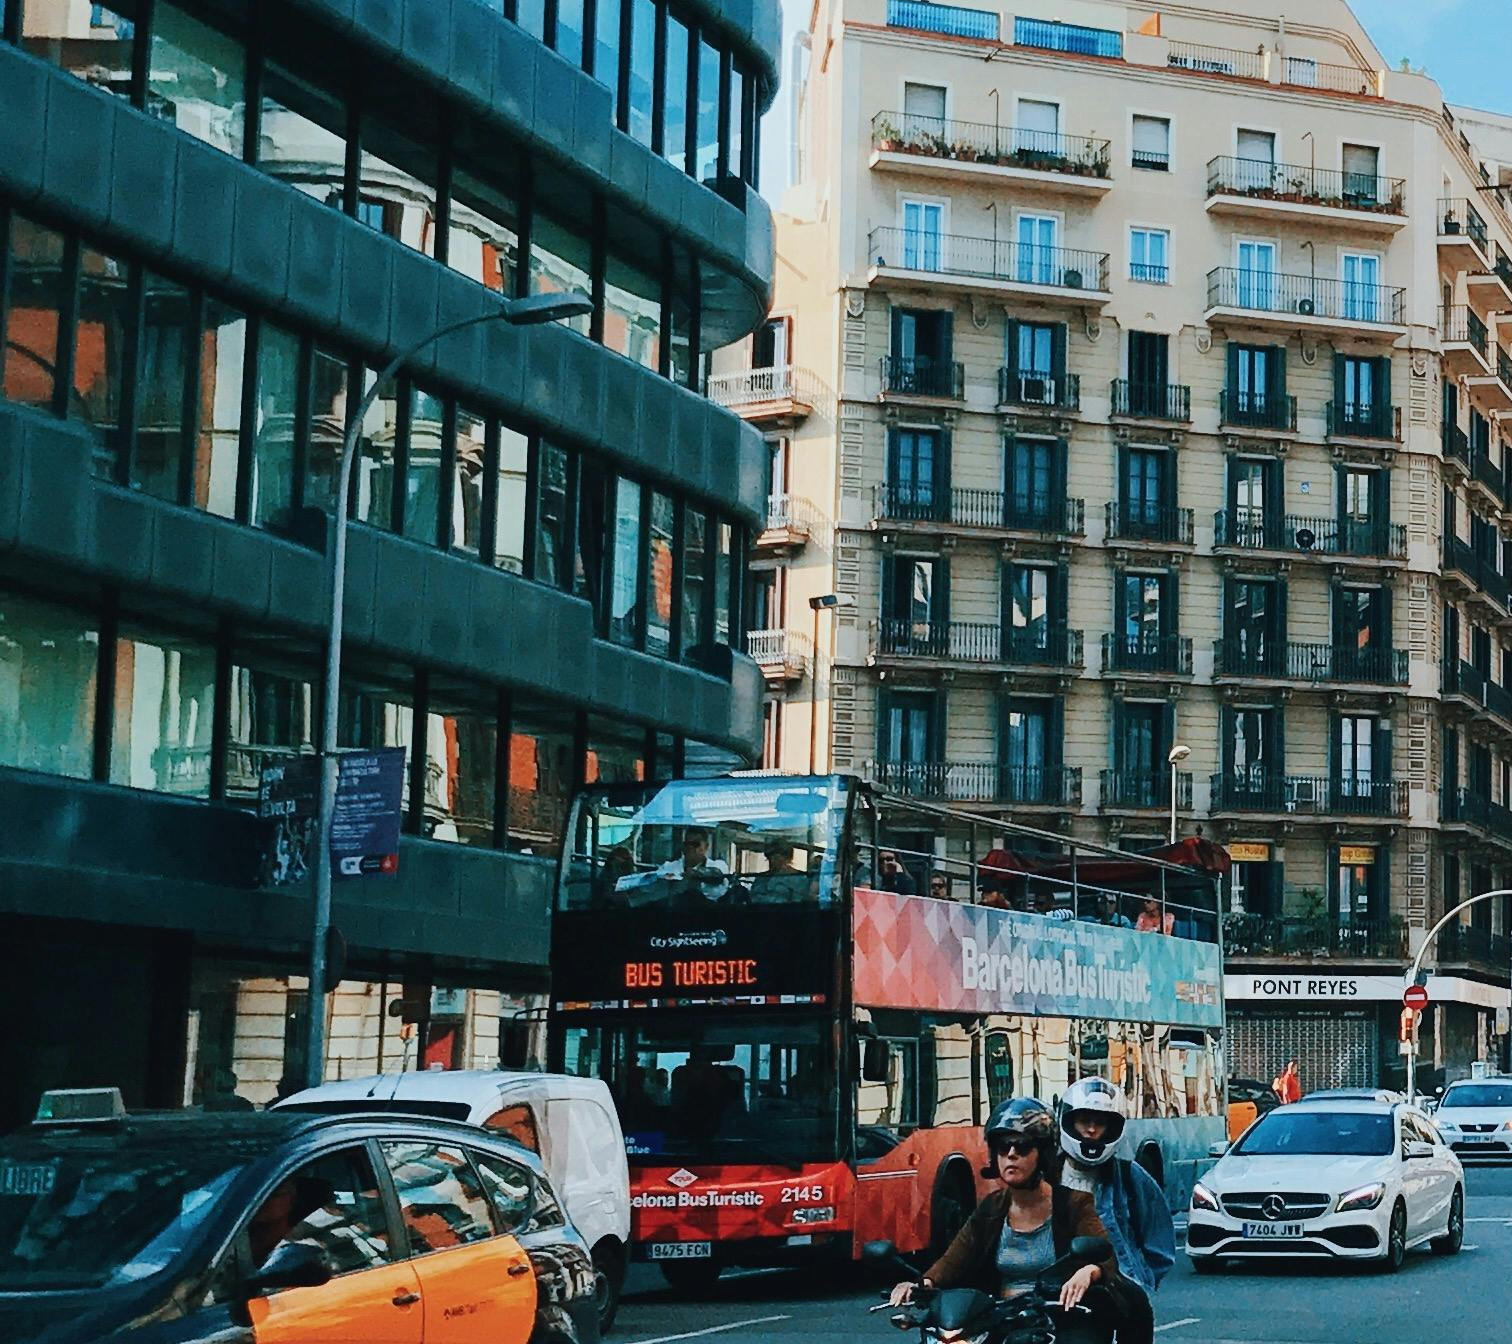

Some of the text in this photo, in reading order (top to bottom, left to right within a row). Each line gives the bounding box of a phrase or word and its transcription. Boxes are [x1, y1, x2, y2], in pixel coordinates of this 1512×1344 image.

[625, 959, 758, 987] BUS TURISTIC
[961, 936, 1065, 997] Barcelona
[1253, 979, 1358, 996] PONT REYES
[630, 1192, 676, 1208] elona
[781, 1185, 824, 1203] 2145
[1249, 1224, 1277, 1236] 7404
[654, 1244, 684, 1257] 9475
